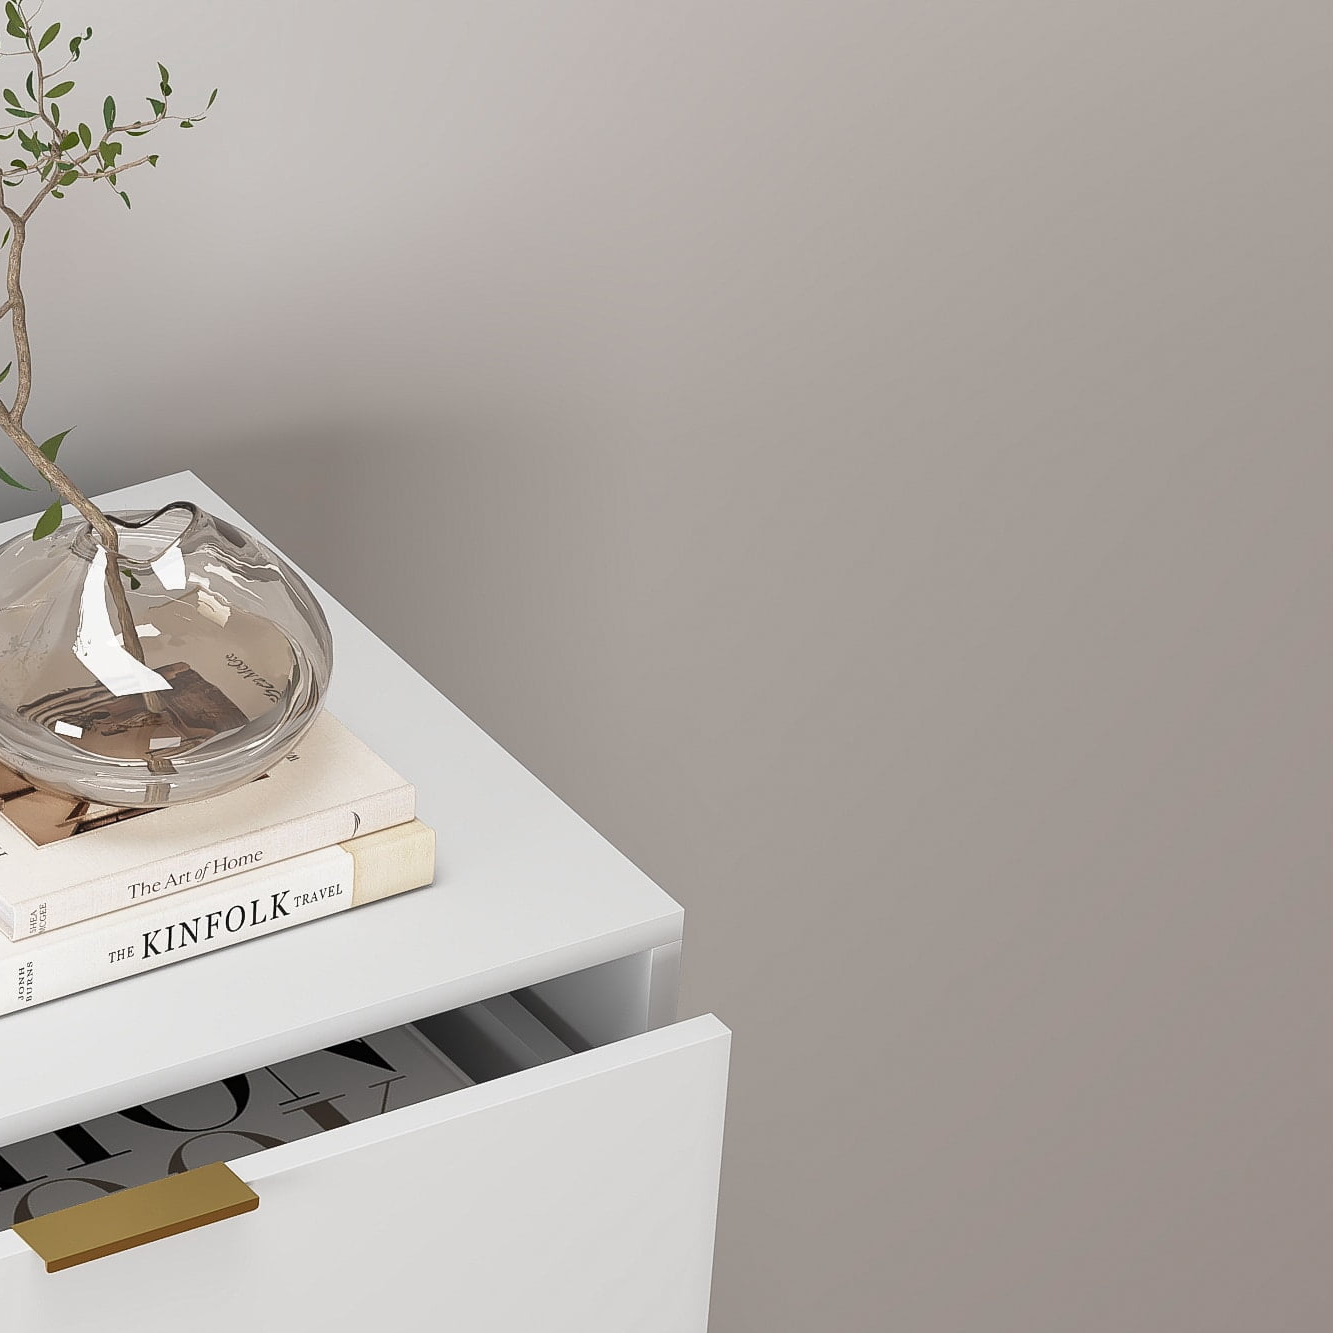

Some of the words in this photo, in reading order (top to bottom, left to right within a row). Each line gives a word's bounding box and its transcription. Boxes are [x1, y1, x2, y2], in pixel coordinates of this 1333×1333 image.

[128, 880, 161, 900] The
[164, 870, 192, 890] Art
[194, 862, 211, 883] of
[213, 850, 263, 874] Home
[29, 909, 38, 935] SHEA
[108, 946, 135, 964] THE
[141, 889, 291, 960] KINFOLK
[293, 883, 343, 909] TRAVEL
[26, 961, 34, 1002] BURNS
